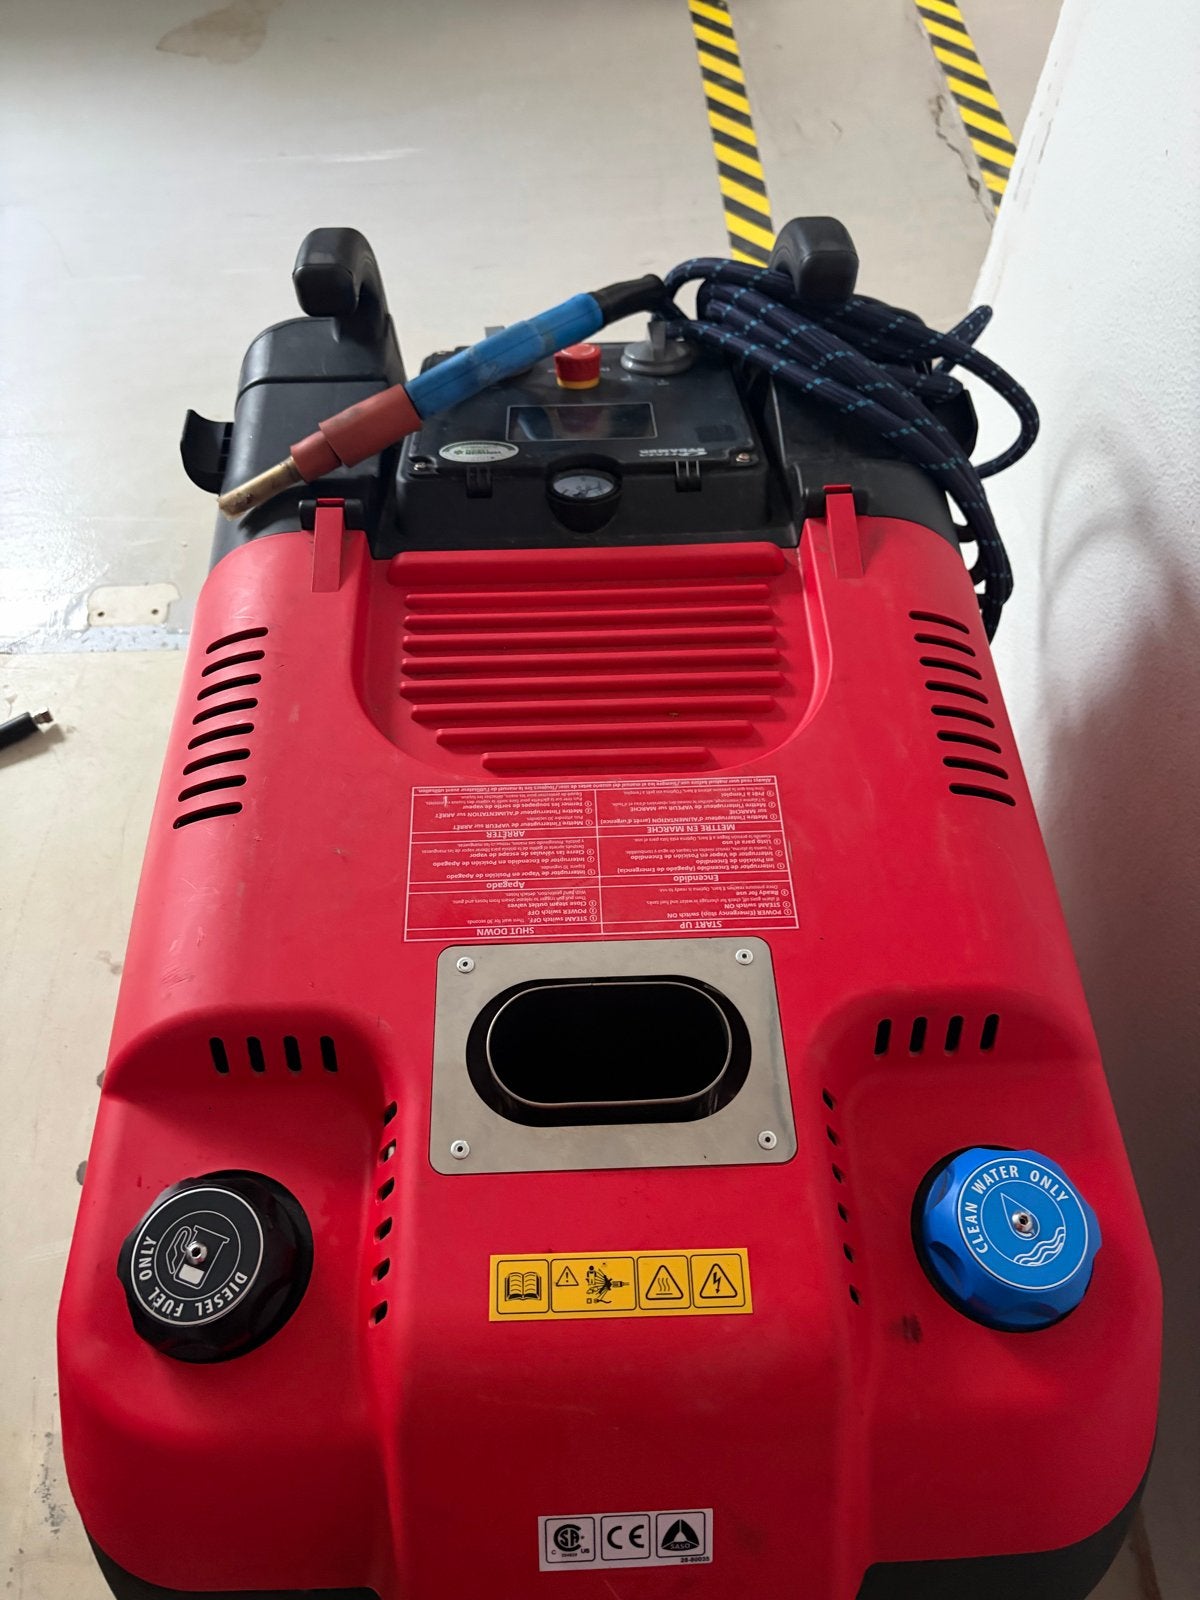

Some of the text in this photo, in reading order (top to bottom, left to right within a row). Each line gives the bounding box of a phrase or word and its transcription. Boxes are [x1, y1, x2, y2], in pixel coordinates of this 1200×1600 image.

[486, 830, 525, 840] ARRÊTER
[673, 875, 719, 883] Encendido
[486, 880, 525, 889] Apagado
[476, 927, 534, 936] SHUT DOWN
[965, 1165, 1070, 1254] CLEAN WATER ONLY
[138, 1235, 248, 1318] DIESEL FUEL ONLY
[607, 1525, 645, 1549] CE
[670, 1542, 691, 1550] SASO
